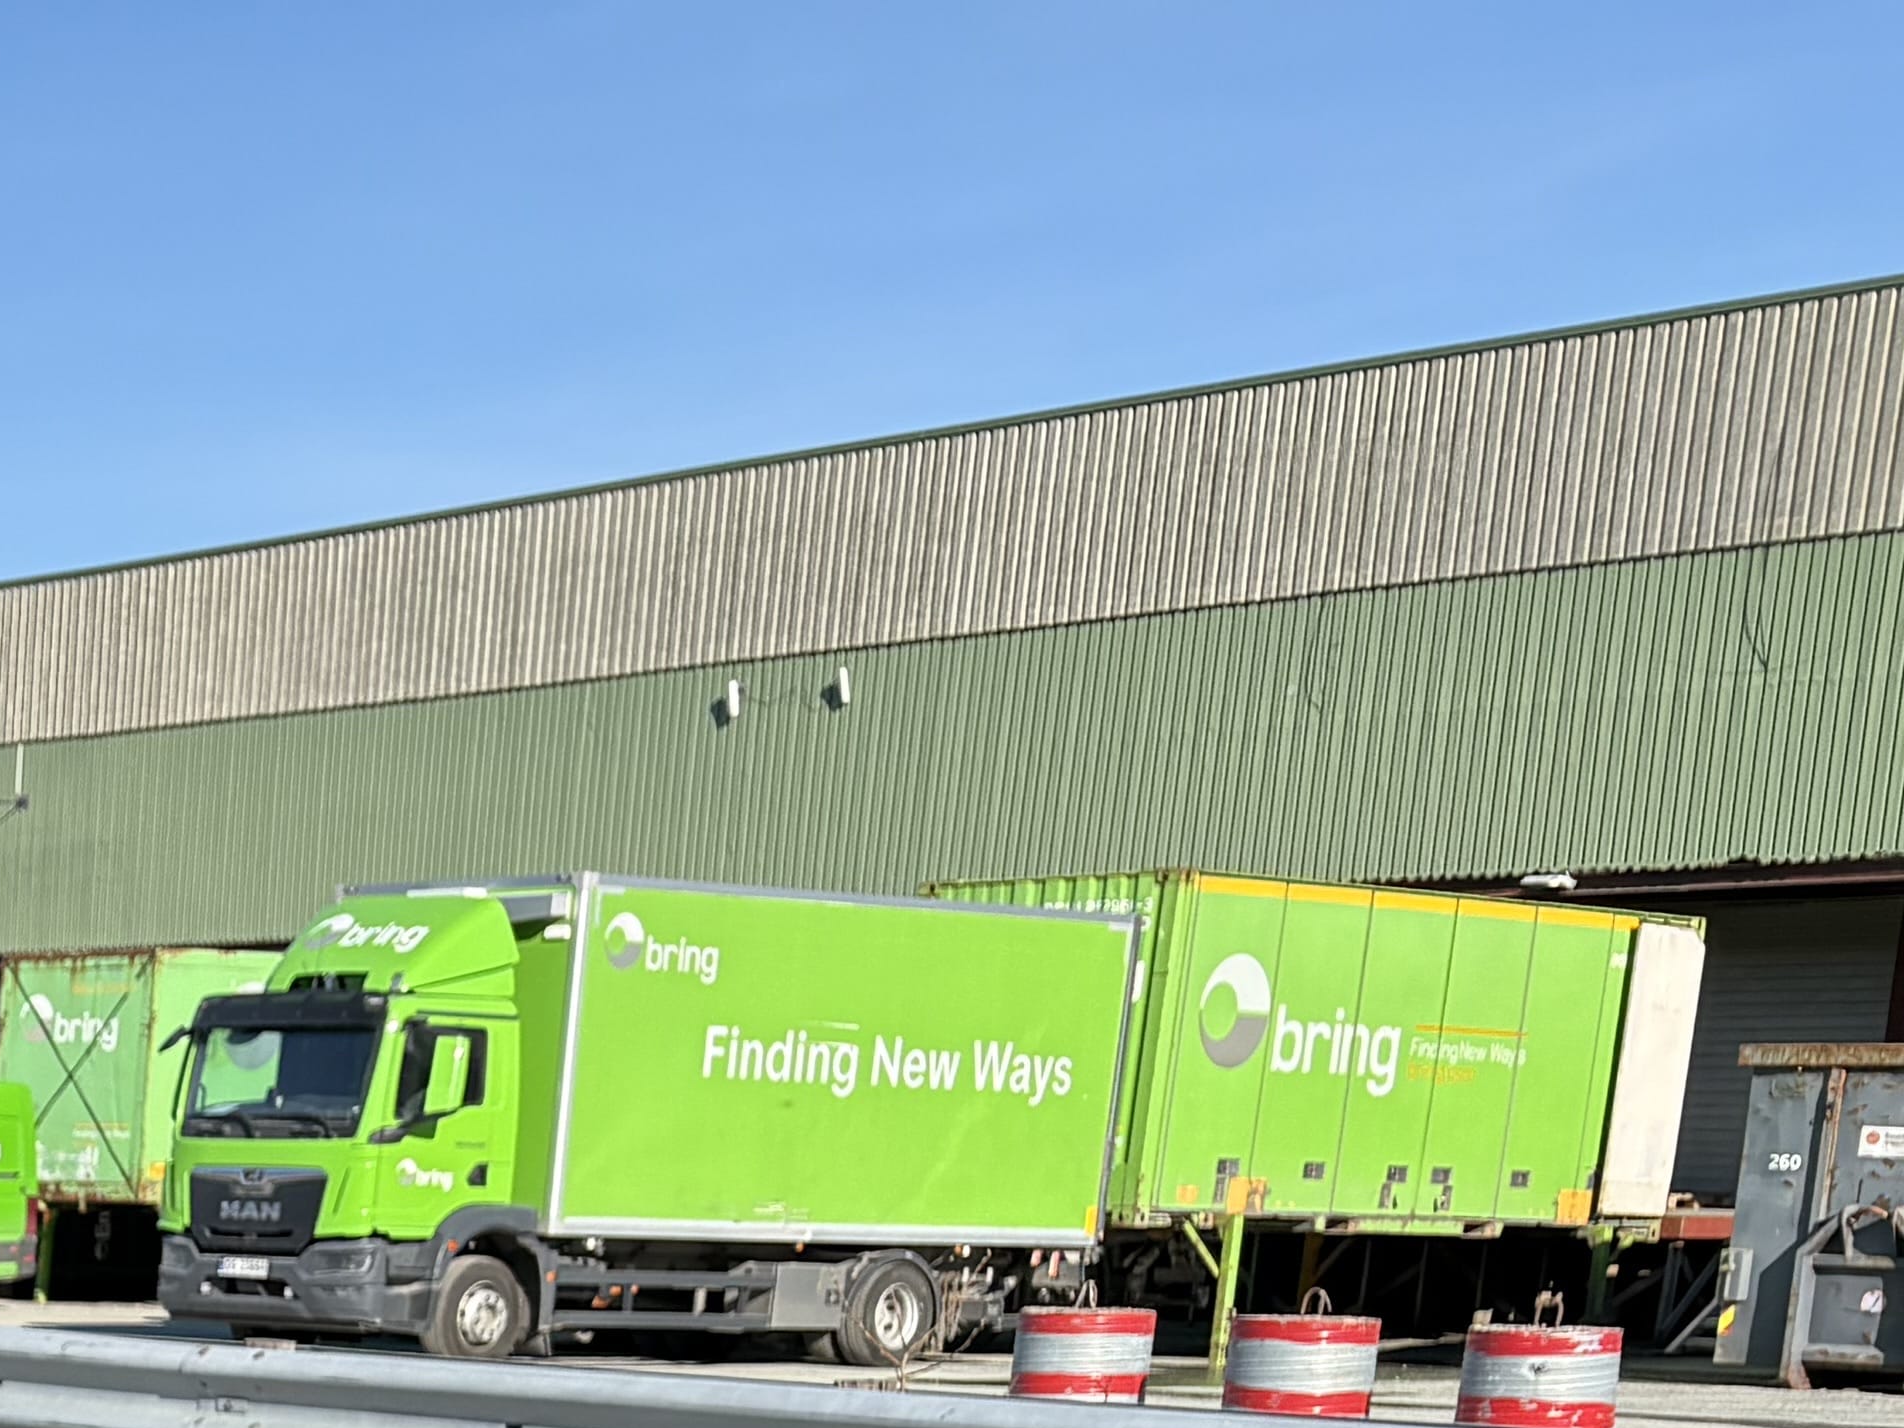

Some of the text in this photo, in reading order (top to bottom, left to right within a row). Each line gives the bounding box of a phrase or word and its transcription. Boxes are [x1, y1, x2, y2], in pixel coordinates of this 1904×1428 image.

[337, 921, 430, 953] bring
[645, 934, 720, 986] bring
[53, 1010, 120, 1053] bring
[1270, 1003, 1402, 1097] bring
[702, 1024, 1074, 1107] Finding New Ways
[1409, 1037, 1459, 1066] Finding
[1768, 1153, 1802, 1171] 260
[219, 1199, 282, 1220] MAN
